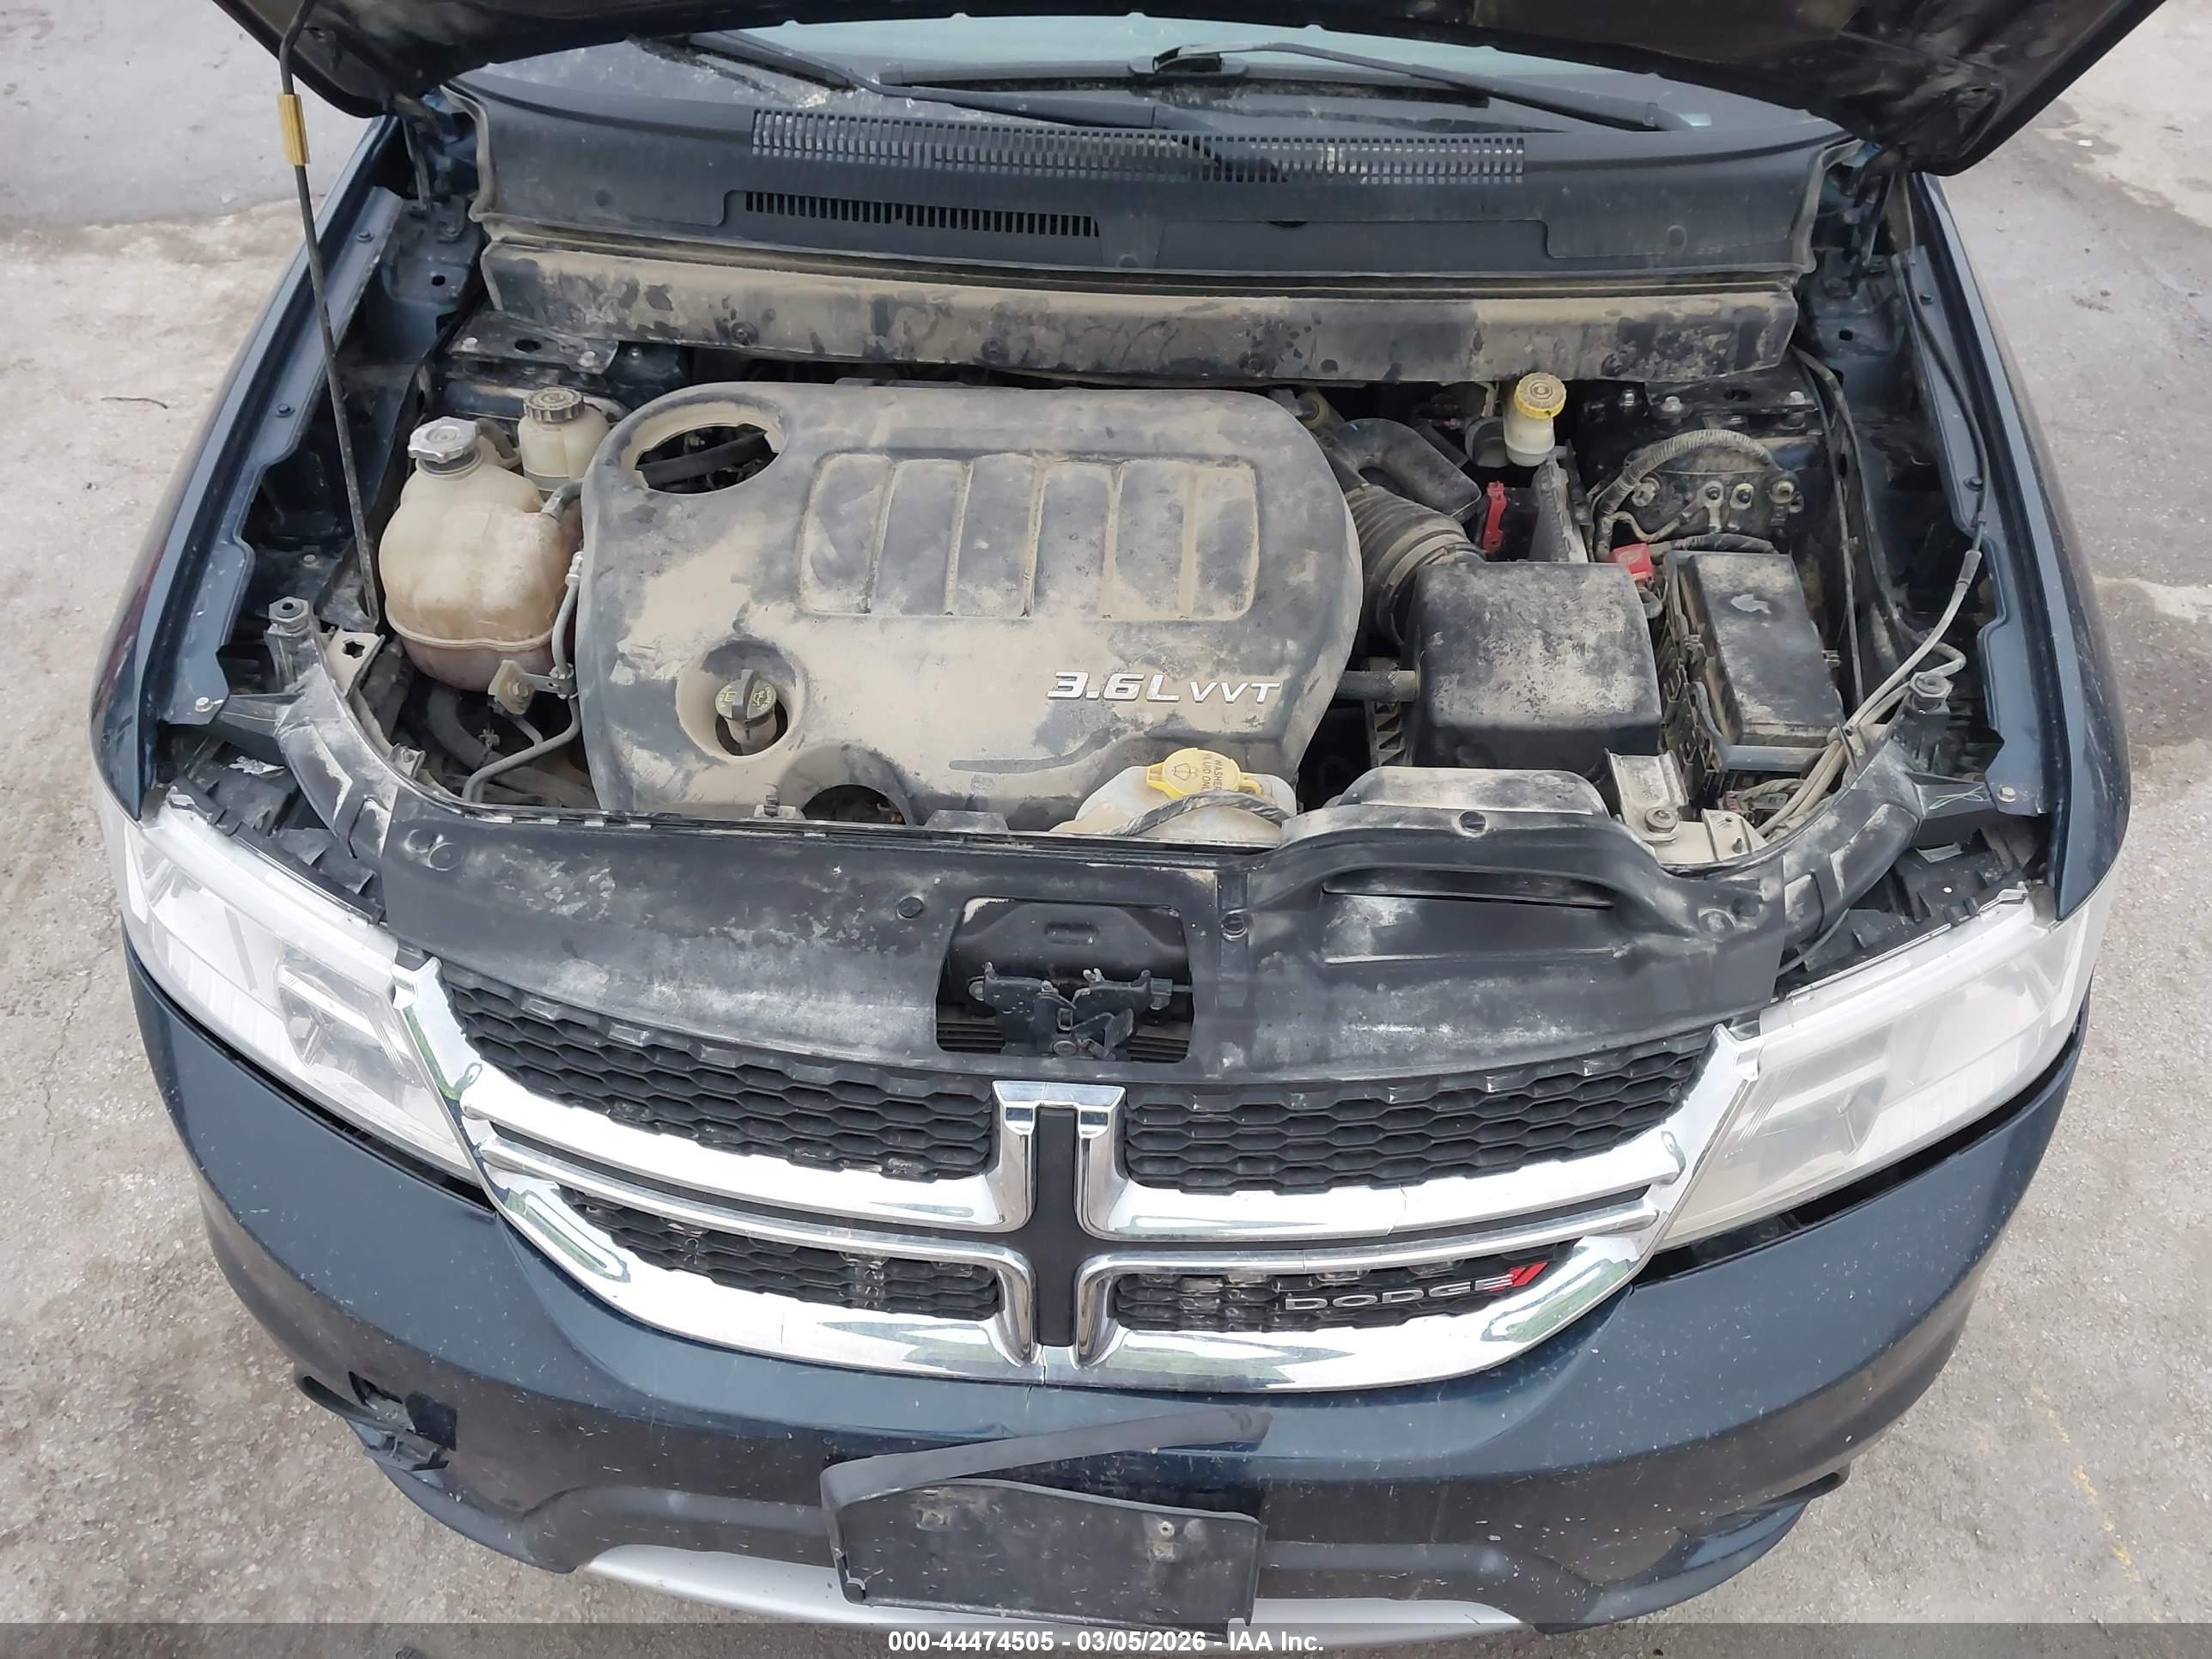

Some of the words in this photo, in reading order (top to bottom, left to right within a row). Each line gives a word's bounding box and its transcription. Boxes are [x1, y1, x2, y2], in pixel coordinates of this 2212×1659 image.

[1047, 672, 1180, 702] 3.6L
[1190, 682, 1280, 703] VVT
[1285, 1274, 1514, 1310] DODGE
